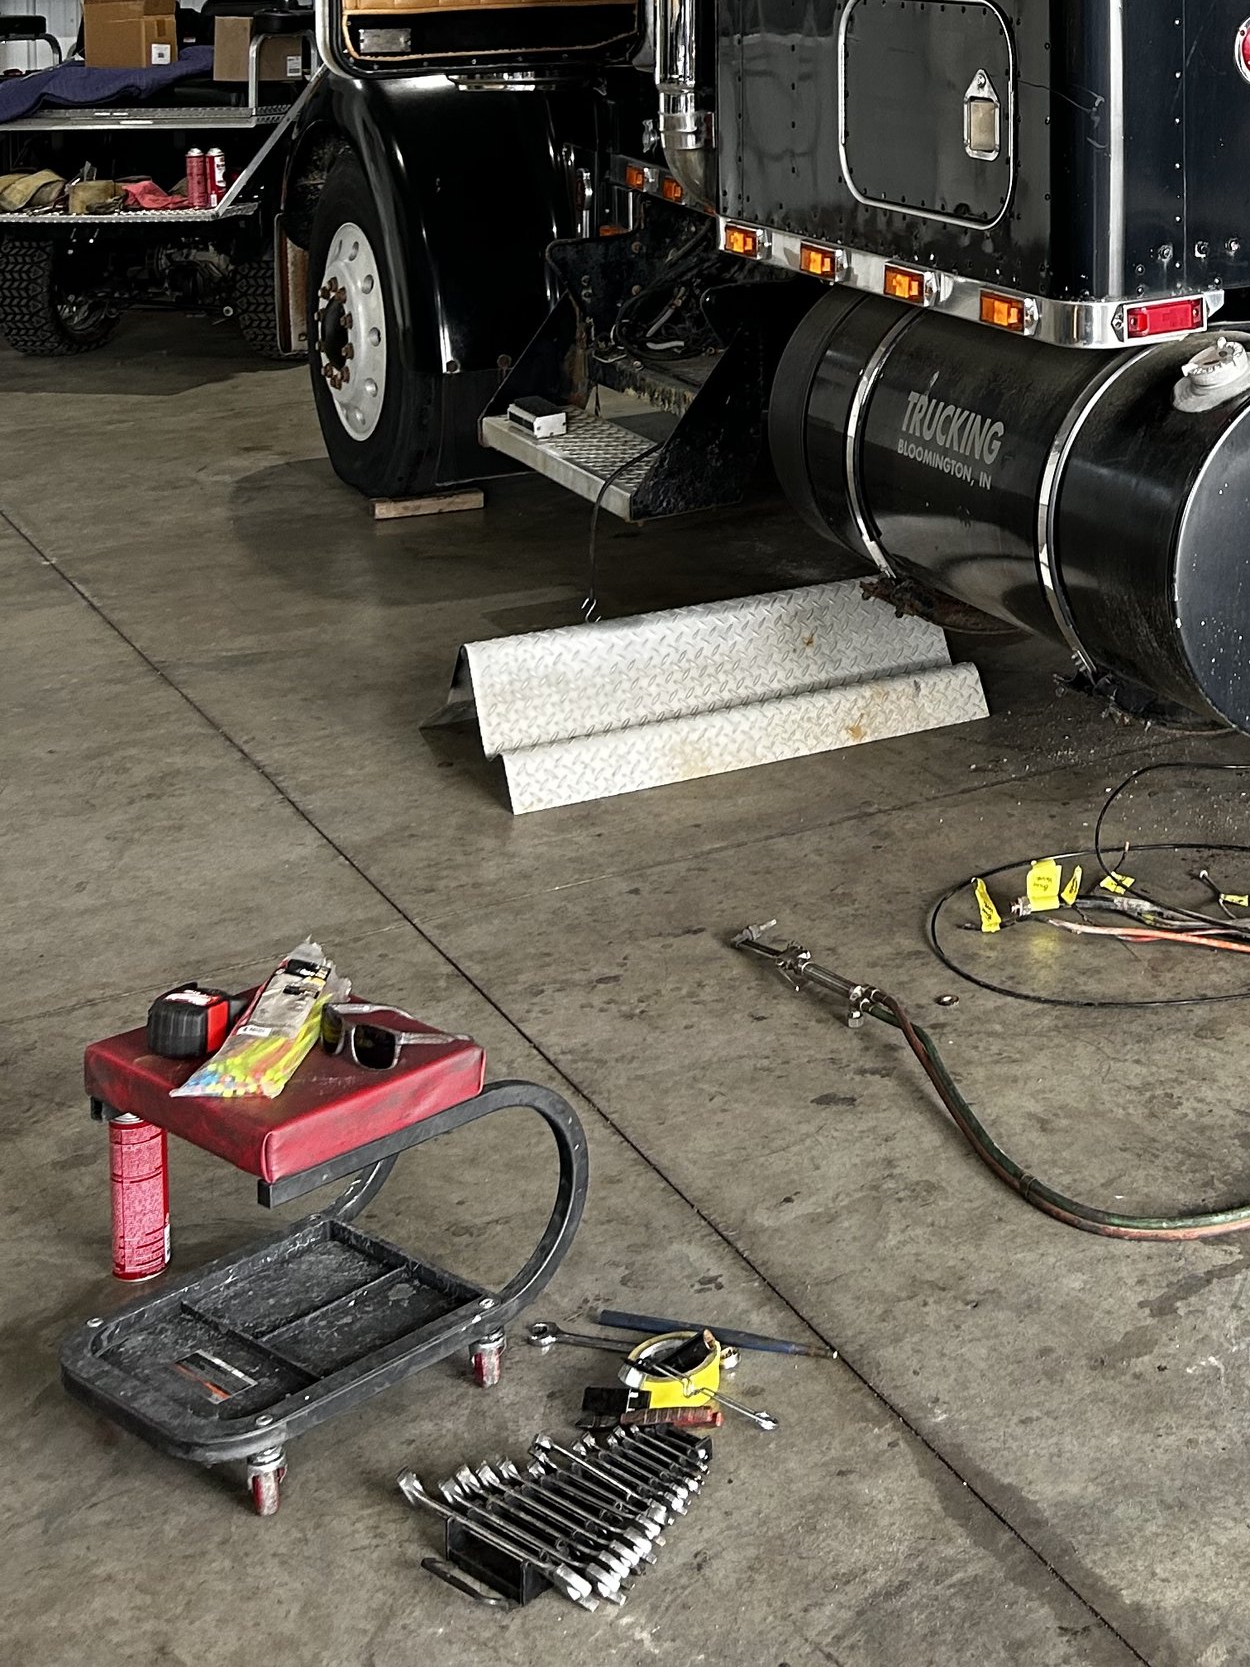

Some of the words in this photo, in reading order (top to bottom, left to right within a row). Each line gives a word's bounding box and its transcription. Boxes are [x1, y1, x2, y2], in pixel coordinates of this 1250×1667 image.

[902, 391, 1004, 465] TRUCKING
[898, 438, 975, 487] BLOOMINGTON,
[979, 471, 992, 490] IN
